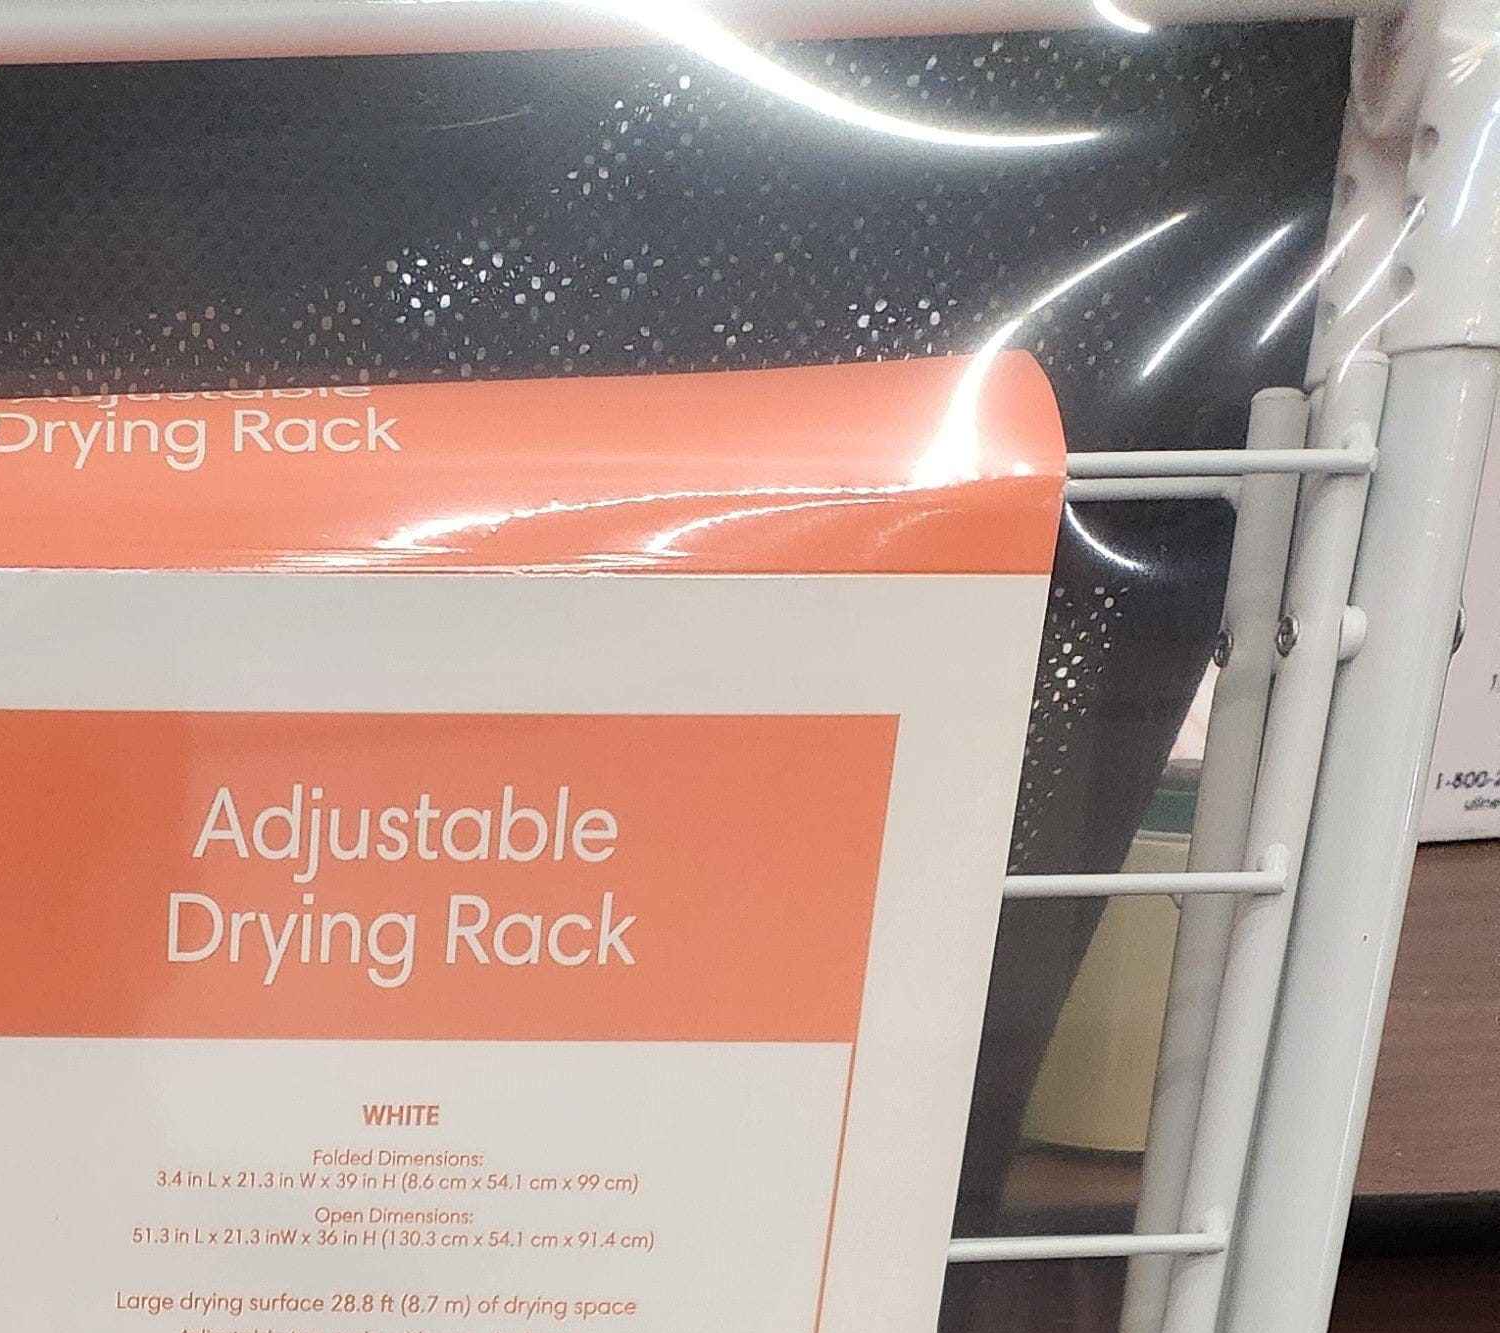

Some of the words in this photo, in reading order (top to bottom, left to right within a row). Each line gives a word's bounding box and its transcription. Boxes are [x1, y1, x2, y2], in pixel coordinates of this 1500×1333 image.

[233, 406, 401, 453] Rack
[192, 783, 619, 883] Adjustable
[167, 891, 417, 989] Drying
[446, 891, 638, 966] Rack
[362, 1104, 440, 1126] WHITE
[313, 1149, 373, 1166] Folded
[378, 1150, 484, 1167] Dimensions:
[157, 1171, 182, 1187] 3.4
[188, 1172, 202, 1187] in
[209, 1172, 217, 1188] L
[222, 1176, 231, 1188] x
[238, 1172, 274, 1188] 21.3
[279, 1173, 293, 1188] in
[300, 1173, 316, 1188] W
[321, 1176, 330, 1188] x
[336, 1173, 357, 1189] 39
[363, 1173, 376, 1189] in
[383, 1174, 396, 1189] H
[401, 1173, 434, 1193] (8.6
[439, 1177, 466, 1190] cm
[472, 1177, 481, 1190] x
[487, 1174, 522, 1190] 54.1
[530, 1178, 556, 1190] cm
[563, 1178, 572, 1190] x
[578, 1174, 599, 1190] 99
[605, 1174, 638, 1195] cm)
[315, 1207, 363, 1227] Open
[369, 1207, 474, 1224] Dimensions:
[132, 1227, 169, 1244] 51.3
[175, 1229, 189, 1243] in
[195, 1229, 203, 1244] L
[209, 1233, 217, 1244] x
[224, 1229, 259, 1244] 21.3
[302, 1233, 310, 1244] x
[317, 1230, 337, 1245] 36
[344, 1230, 357, 1245] in
[363, 1231, 376, 1245] H
[382, 1230, 436, 1249] (130.3
[441, 1235, 468, 1246] cm
[474, 1235, 483, 1246] x
[489, 1231, 523, 1247] 54.1
[531, 1235, 558, 1247] cm
[564, 1236, 573, 1247] x
[579, 1232, 615, 1248] 91.4
[621, 1232, 654, 1252] cm)
[117, 1291, 173, 1315] Large
[180, 1292, 243, 1316] drying
[250, 1293, 324, 1312] surface
[331, 1294, 374, 1313] 28.8
[379, 1294, 394, 1313] ft
[401, 1293, 439, 1318] (8.7
[445, 1295, 471, 1318] m)
[478, 1296, 498, 1315] of
[504, 1296, 567, 1320] drying
[574, 1301, 637, 1320] space
